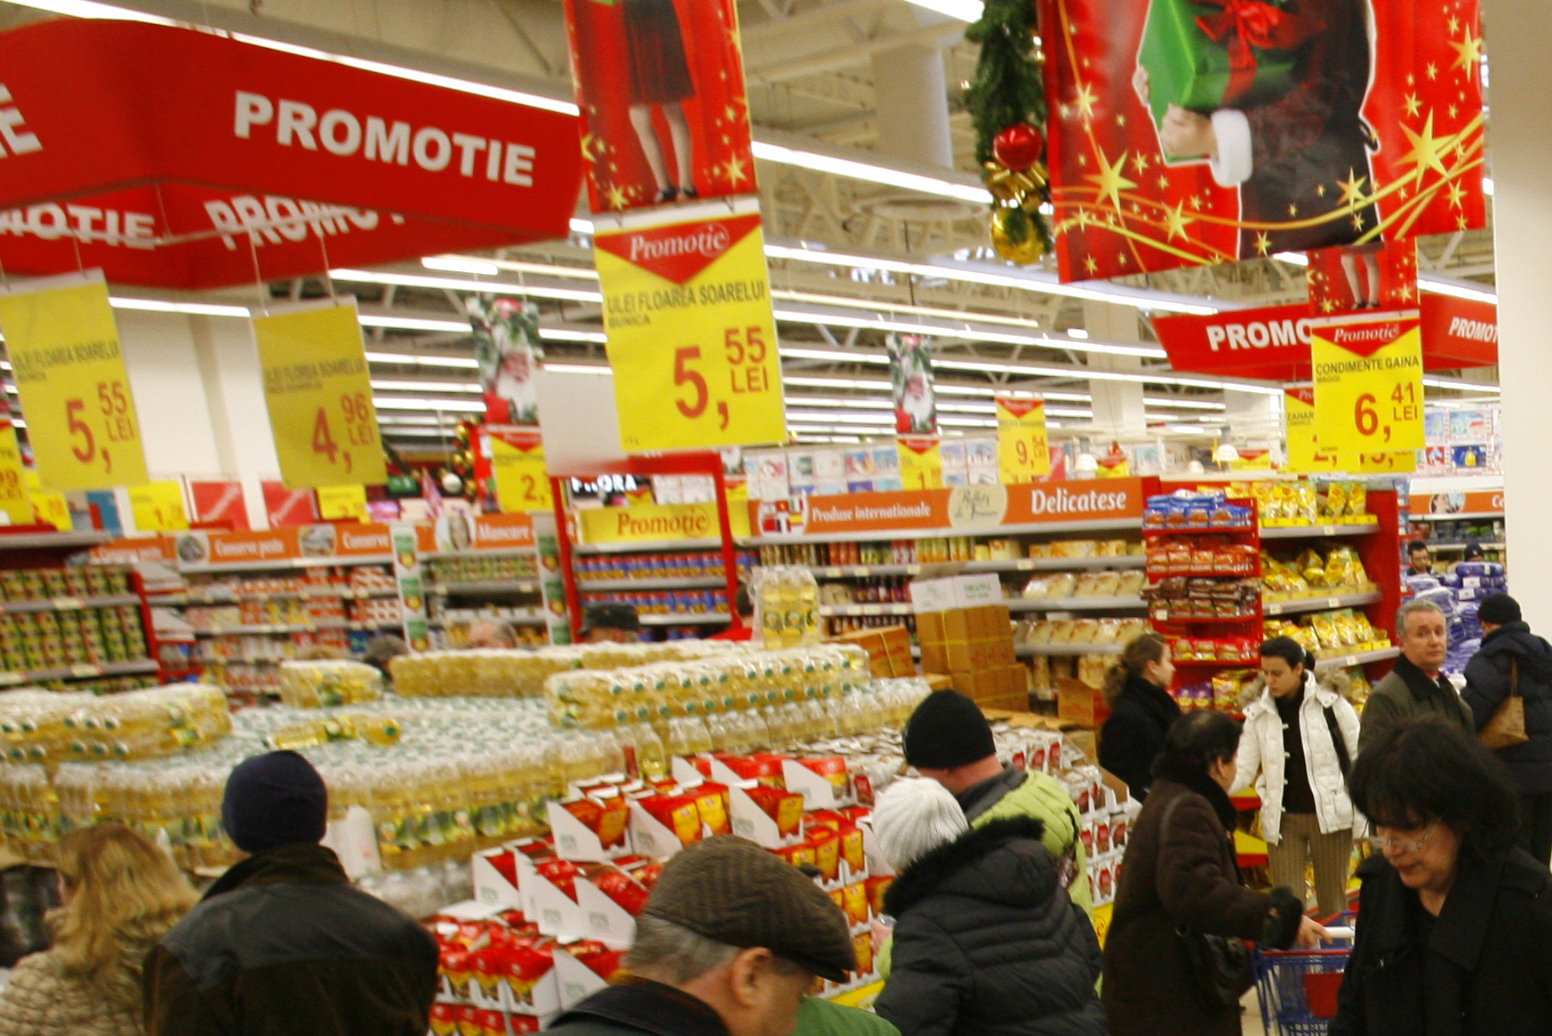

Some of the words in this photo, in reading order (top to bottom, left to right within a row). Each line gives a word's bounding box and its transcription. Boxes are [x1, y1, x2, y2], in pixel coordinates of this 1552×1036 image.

[0, 83, 44, 159] E
[234, 90, 536, 187] PROMOTIE
[204, 195, 404, 250] PROMO
[630, 225, 730, 262] Promotie
[607, 292, 637, 314] ULEI
[638, 286, 697, 311] FLOAREA
[699, 280, 765, 305] SOARELUI
[1334, 323, 1398, 344] Promotie
[674, 346, 729, 431] 5,
[724, 325, 767, 366] 55
[730, 365, 769, 394] LEI
[1316, 359, 1382, 375] CONDIMENTE
[1385, 356, 1419, 369] GAINA
[66, 398, 112, 475] 5,
[97, 380, 128, 417] 55
[1354, 392, 1391, 443] 6,
[1391, 381, 1414, 404] 41
[1393, 405, 1418, 421] LEI
[105, 416, 135, 442] LEI
[312, 407, 353, 473] 4,
[340, 392, 370, 423] 96
[346, 422, 375, 446] LEI
[812, 503, 852, 522] Produse
[854, 499, 931, 520] internationale
[1031, 487, 1128, 515] Delicatese
[617, 507, 708, 535] Promotie
